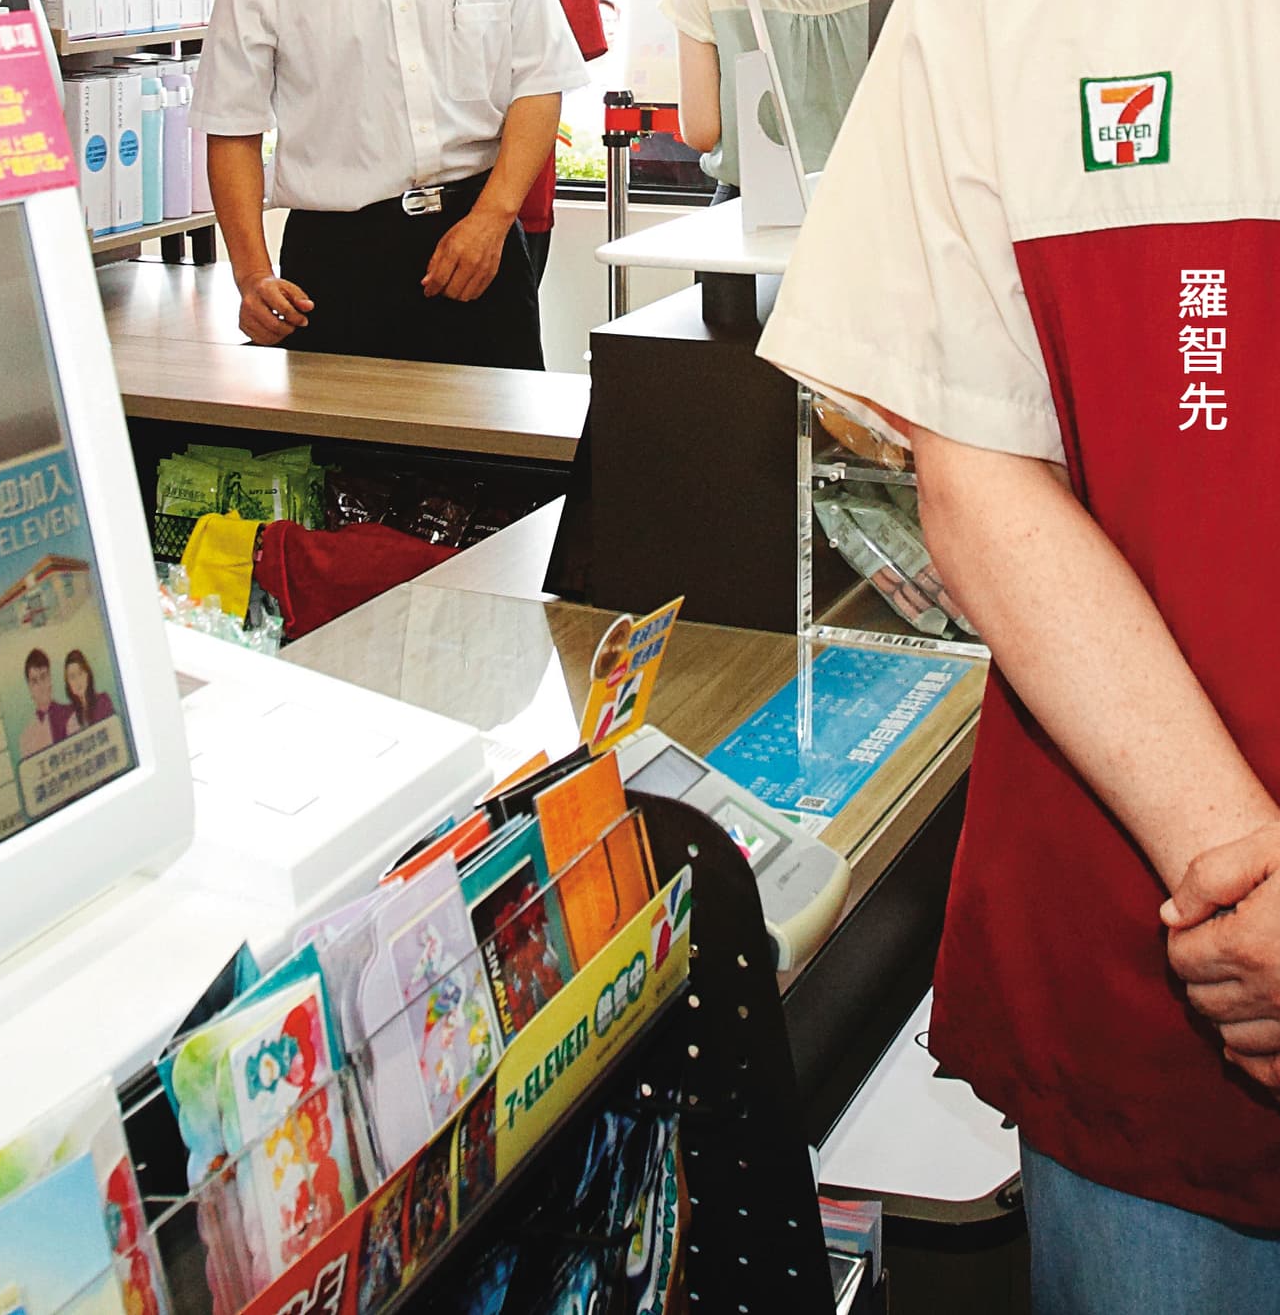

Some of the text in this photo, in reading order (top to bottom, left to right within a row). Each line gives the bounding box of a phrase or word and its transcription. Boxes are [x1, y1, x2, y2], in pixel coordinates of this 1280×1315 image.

[846, 671, 954, 765] 提供自備飲料杯優惠
